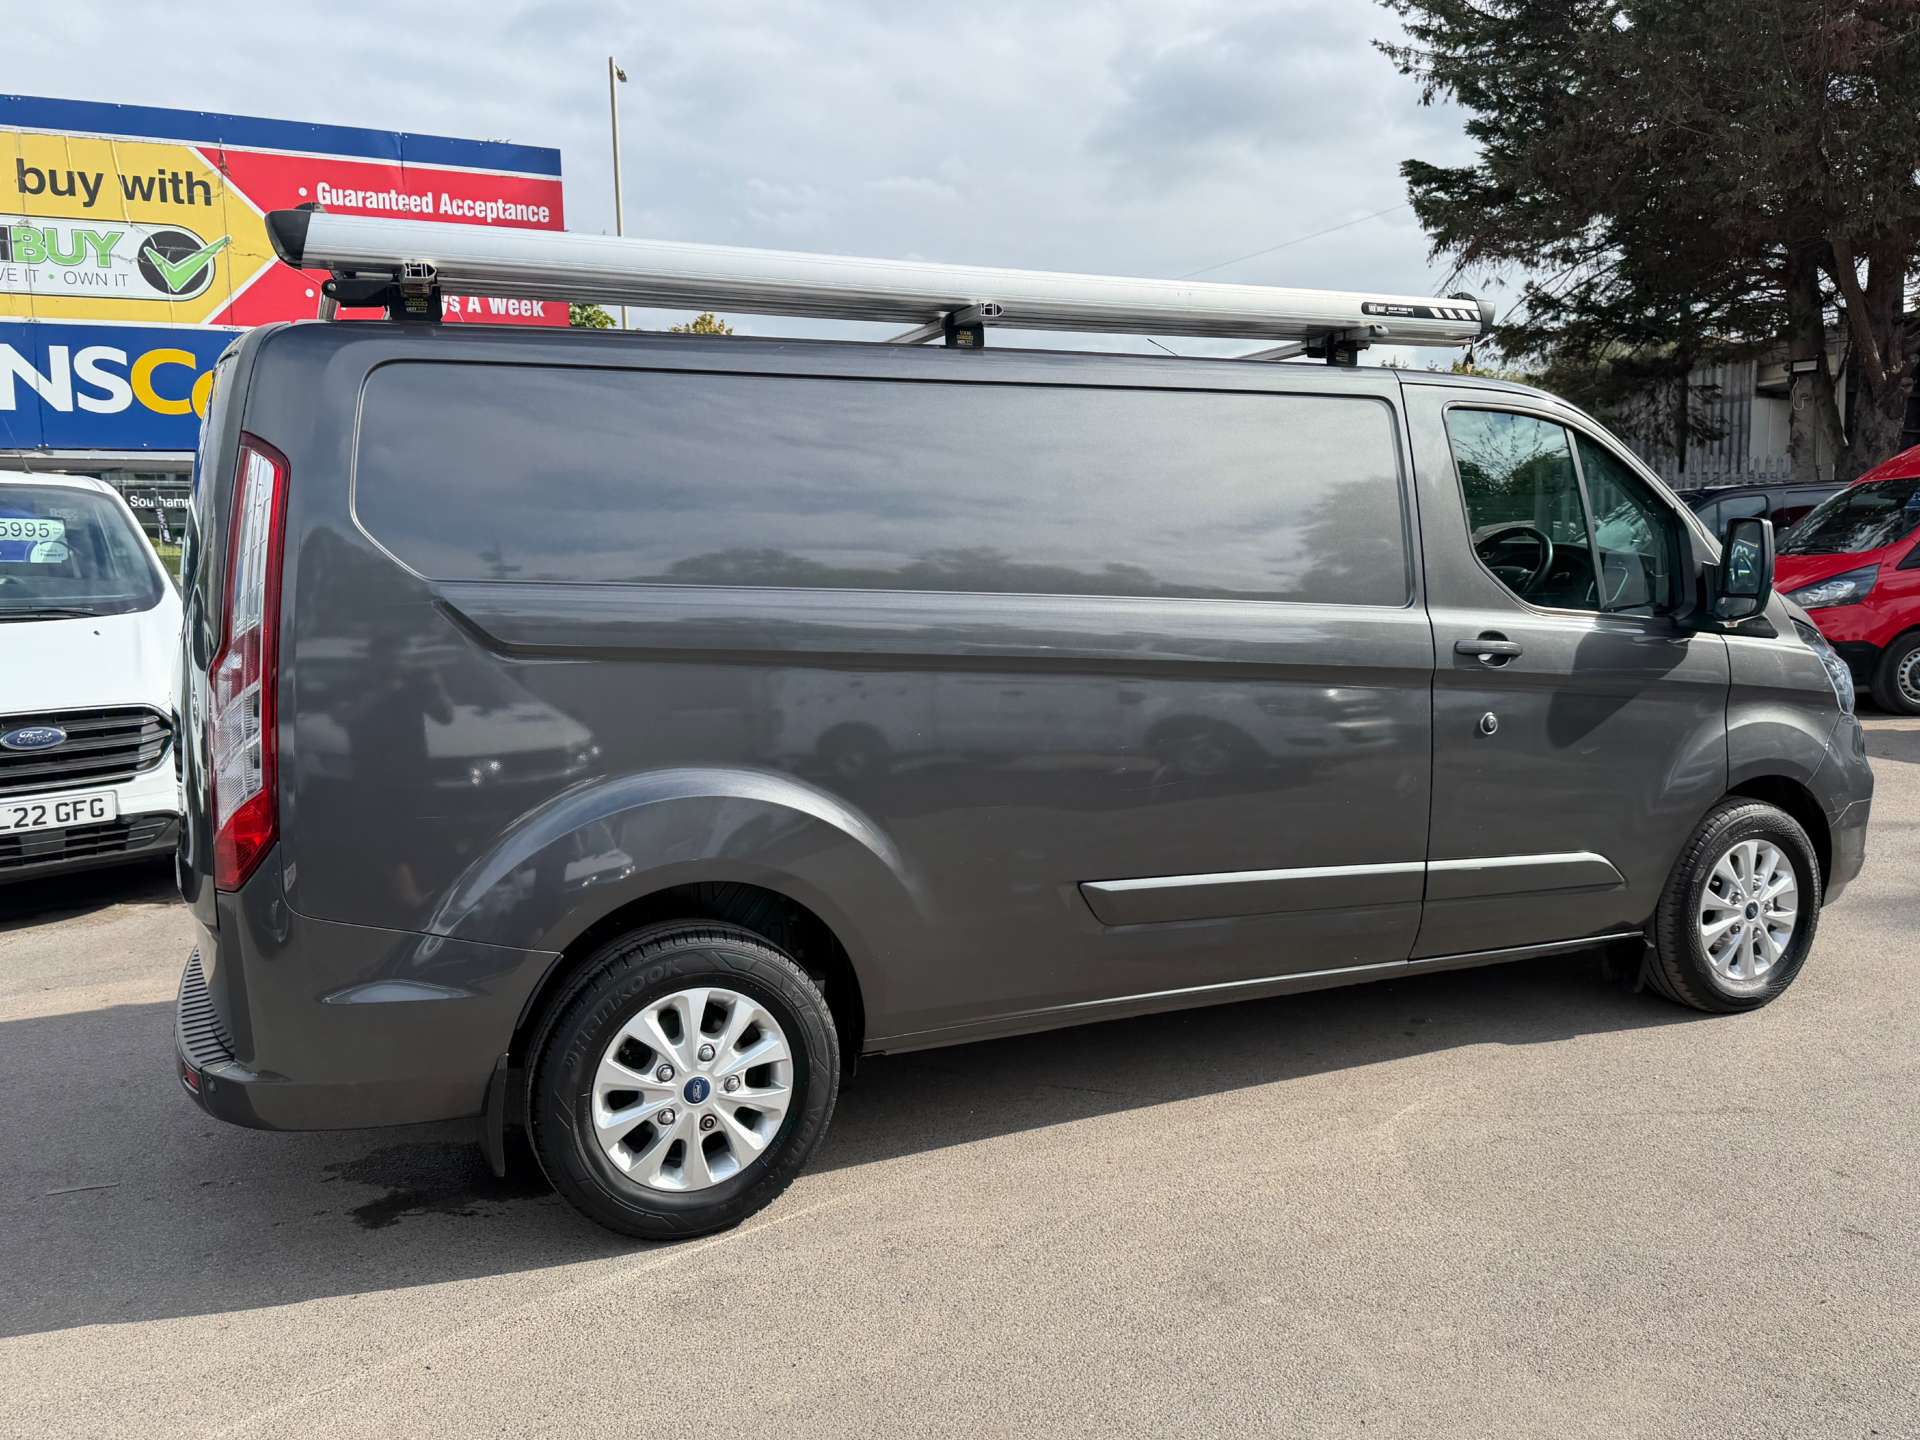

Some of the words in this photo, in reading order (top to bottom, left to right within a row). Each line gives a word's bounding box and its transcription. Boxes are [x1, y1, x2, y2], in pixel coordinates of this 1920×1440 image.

[15, 157, 104, 208] buy
[117, 168, 213, 207] with
[316, 181, 433, 214] Guaranteed
[439, 192, 550, 224] Acceptance
[25, 268, 40, 283] IT
[63, 270, 108, 287] OWN
[114, 273, 129, 288] IT
[467, 296, 482, 313] A
[55, 797, 104, 823] GFG
